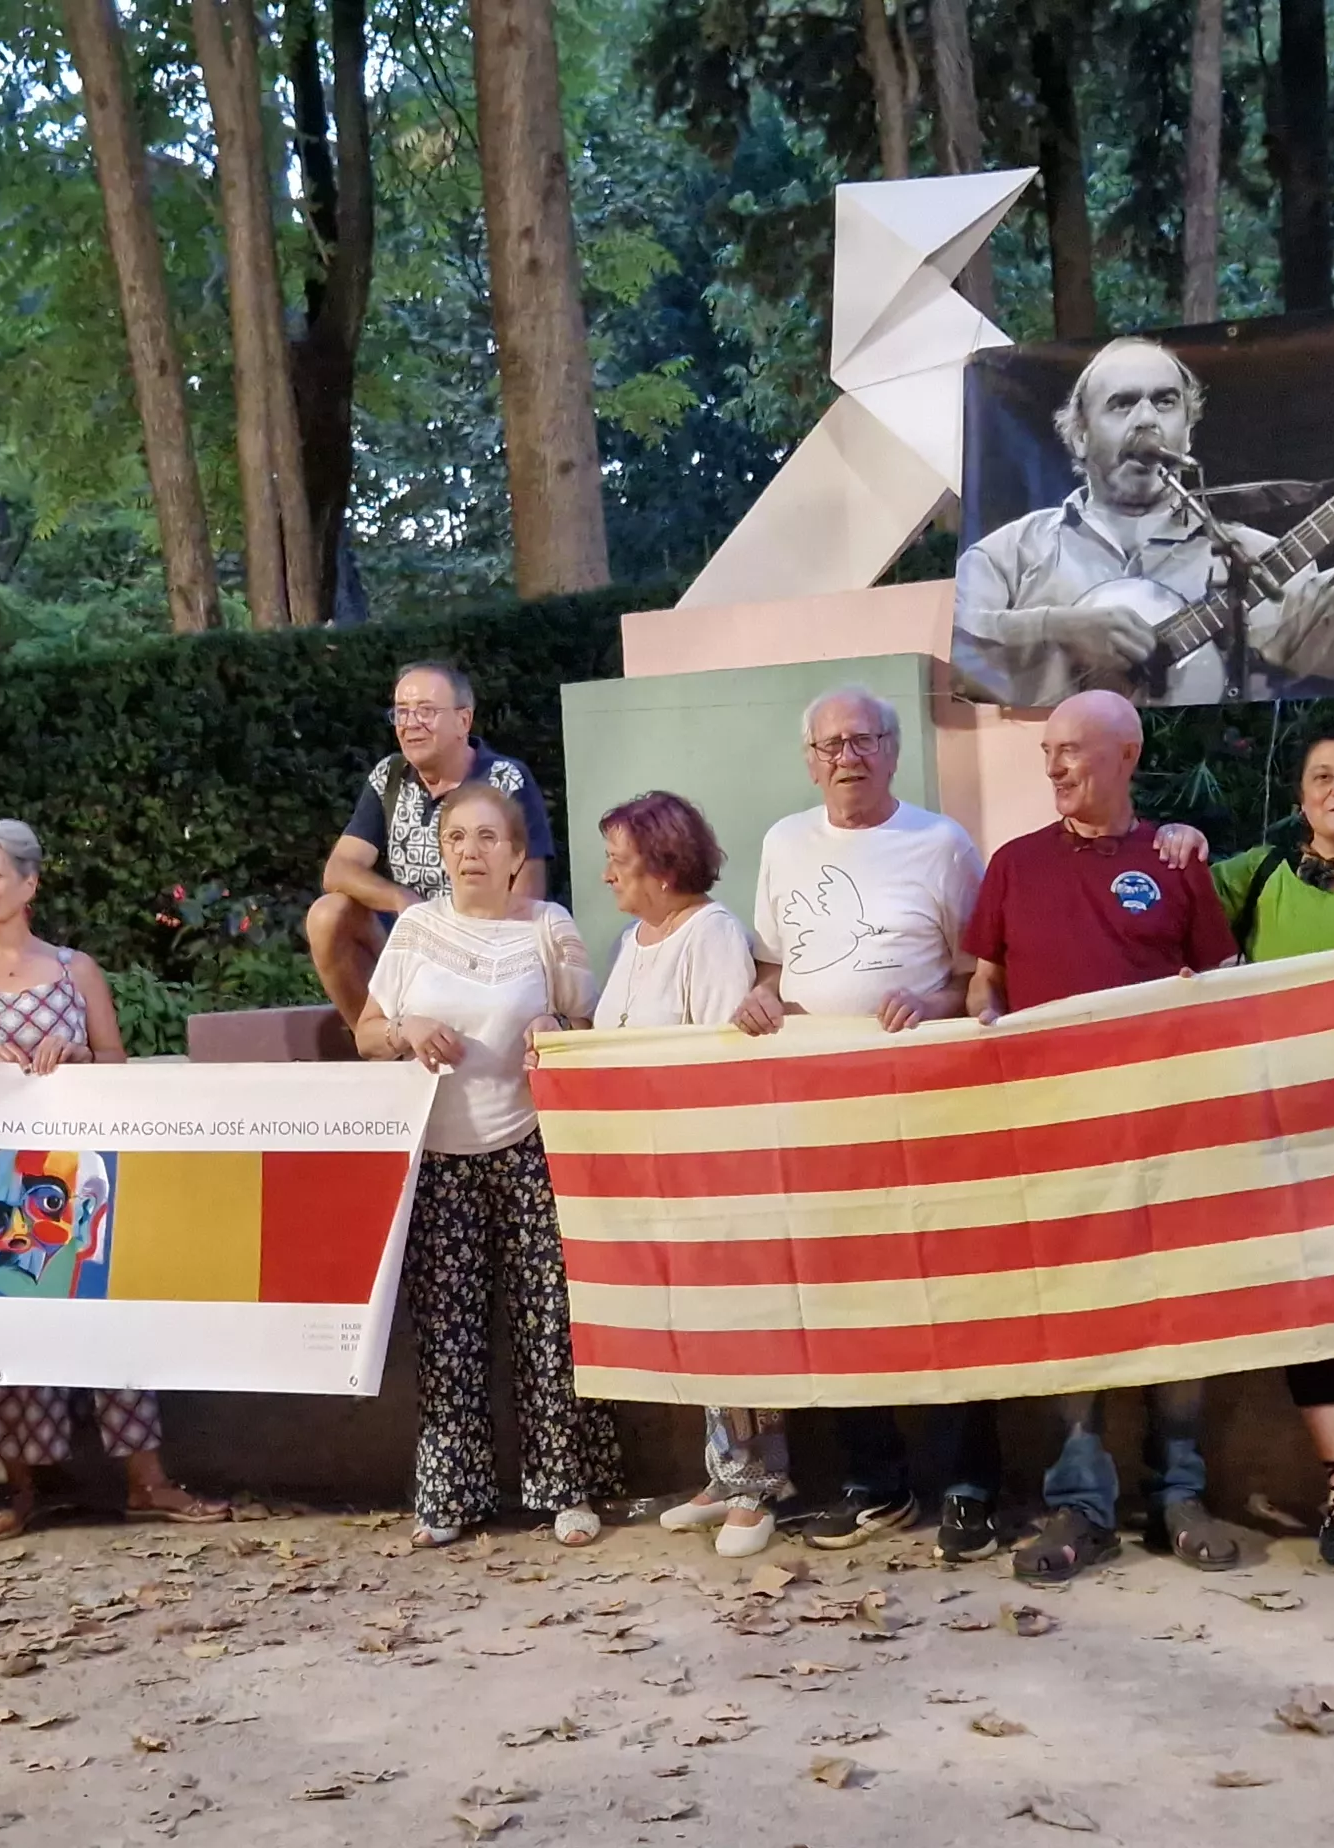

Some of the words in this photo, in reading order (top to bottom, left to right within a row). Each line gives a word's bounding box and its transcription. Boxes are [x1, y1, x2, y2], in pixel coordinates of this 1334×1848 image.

[31, 1120, 106, 1136] CULTURAL
[109, 1121, 205, 1136] ARAGONESA
[209, 1118, 245, 1136] JOSÉ
[249, 1120, 320, 1136] ANTONIO
[323, 1120, 412, 1136] LABORDETA
